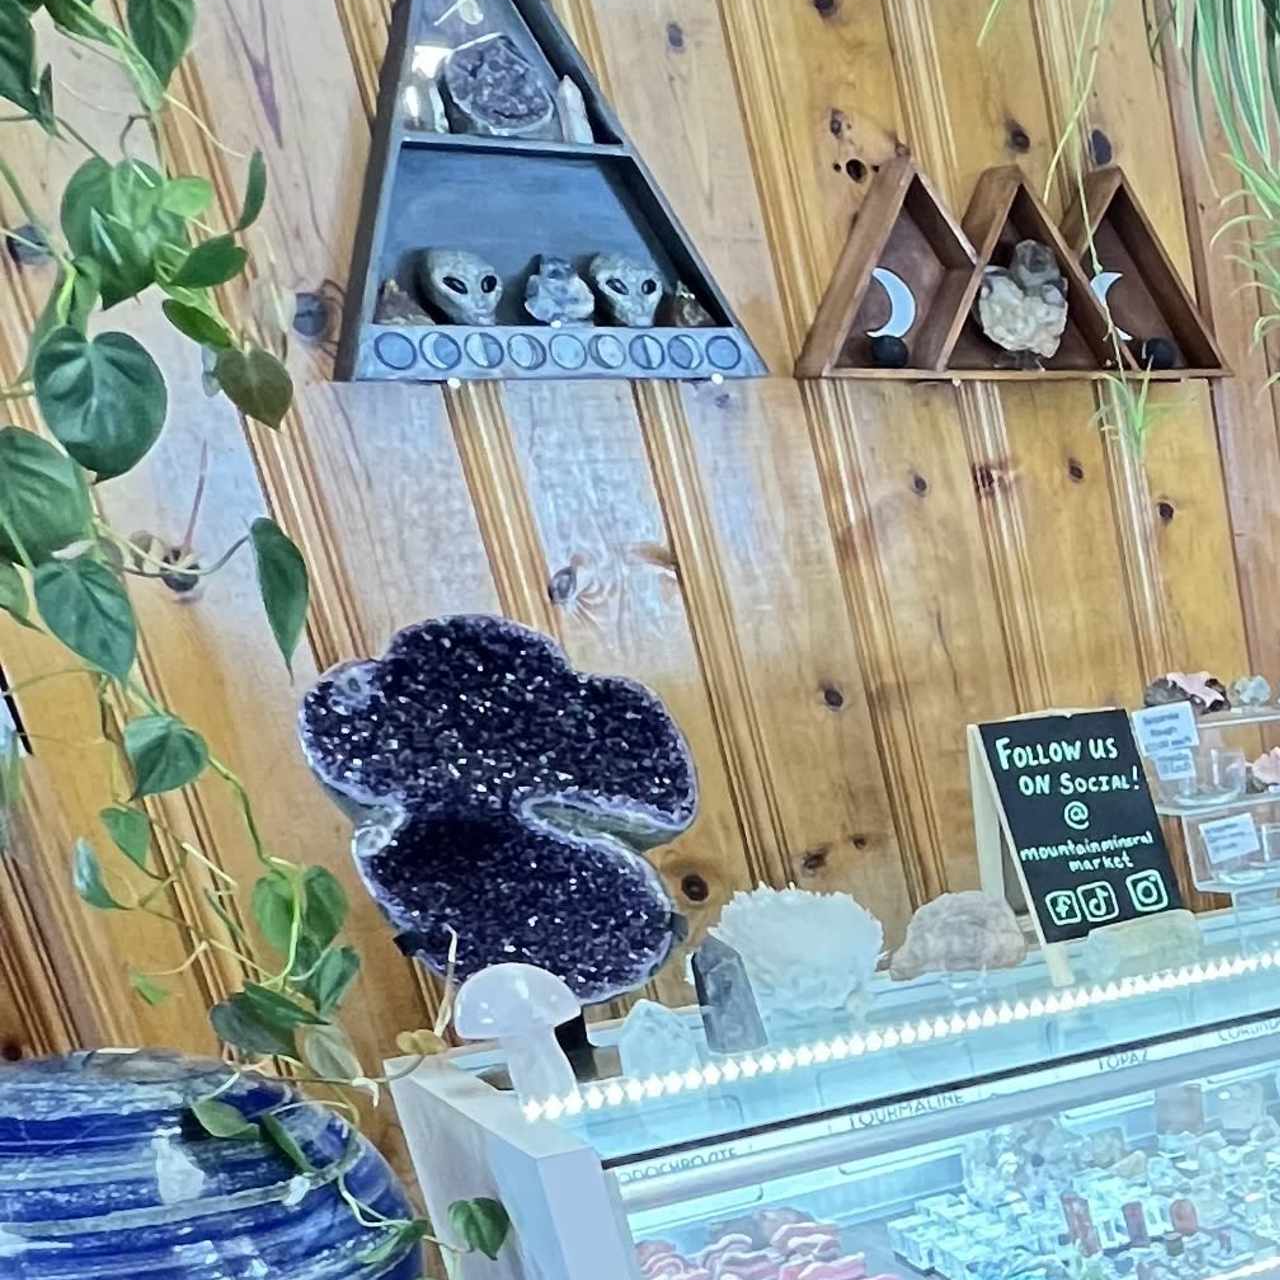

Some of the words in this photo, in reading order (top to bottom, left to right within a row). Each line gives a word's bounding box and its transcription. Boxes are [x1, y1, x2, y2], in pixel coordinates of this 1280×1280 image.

[995, 737, 1081, 770] FOLLOW
[1018, 774, 1050, 796] ON
[1059, 766, 1140, 795] SOCIAL!
[1063, 801, 1090, 830] @
[1069, 850, 1134, 872] market
[849, 1094, 965, 1128] TOURMALINE
